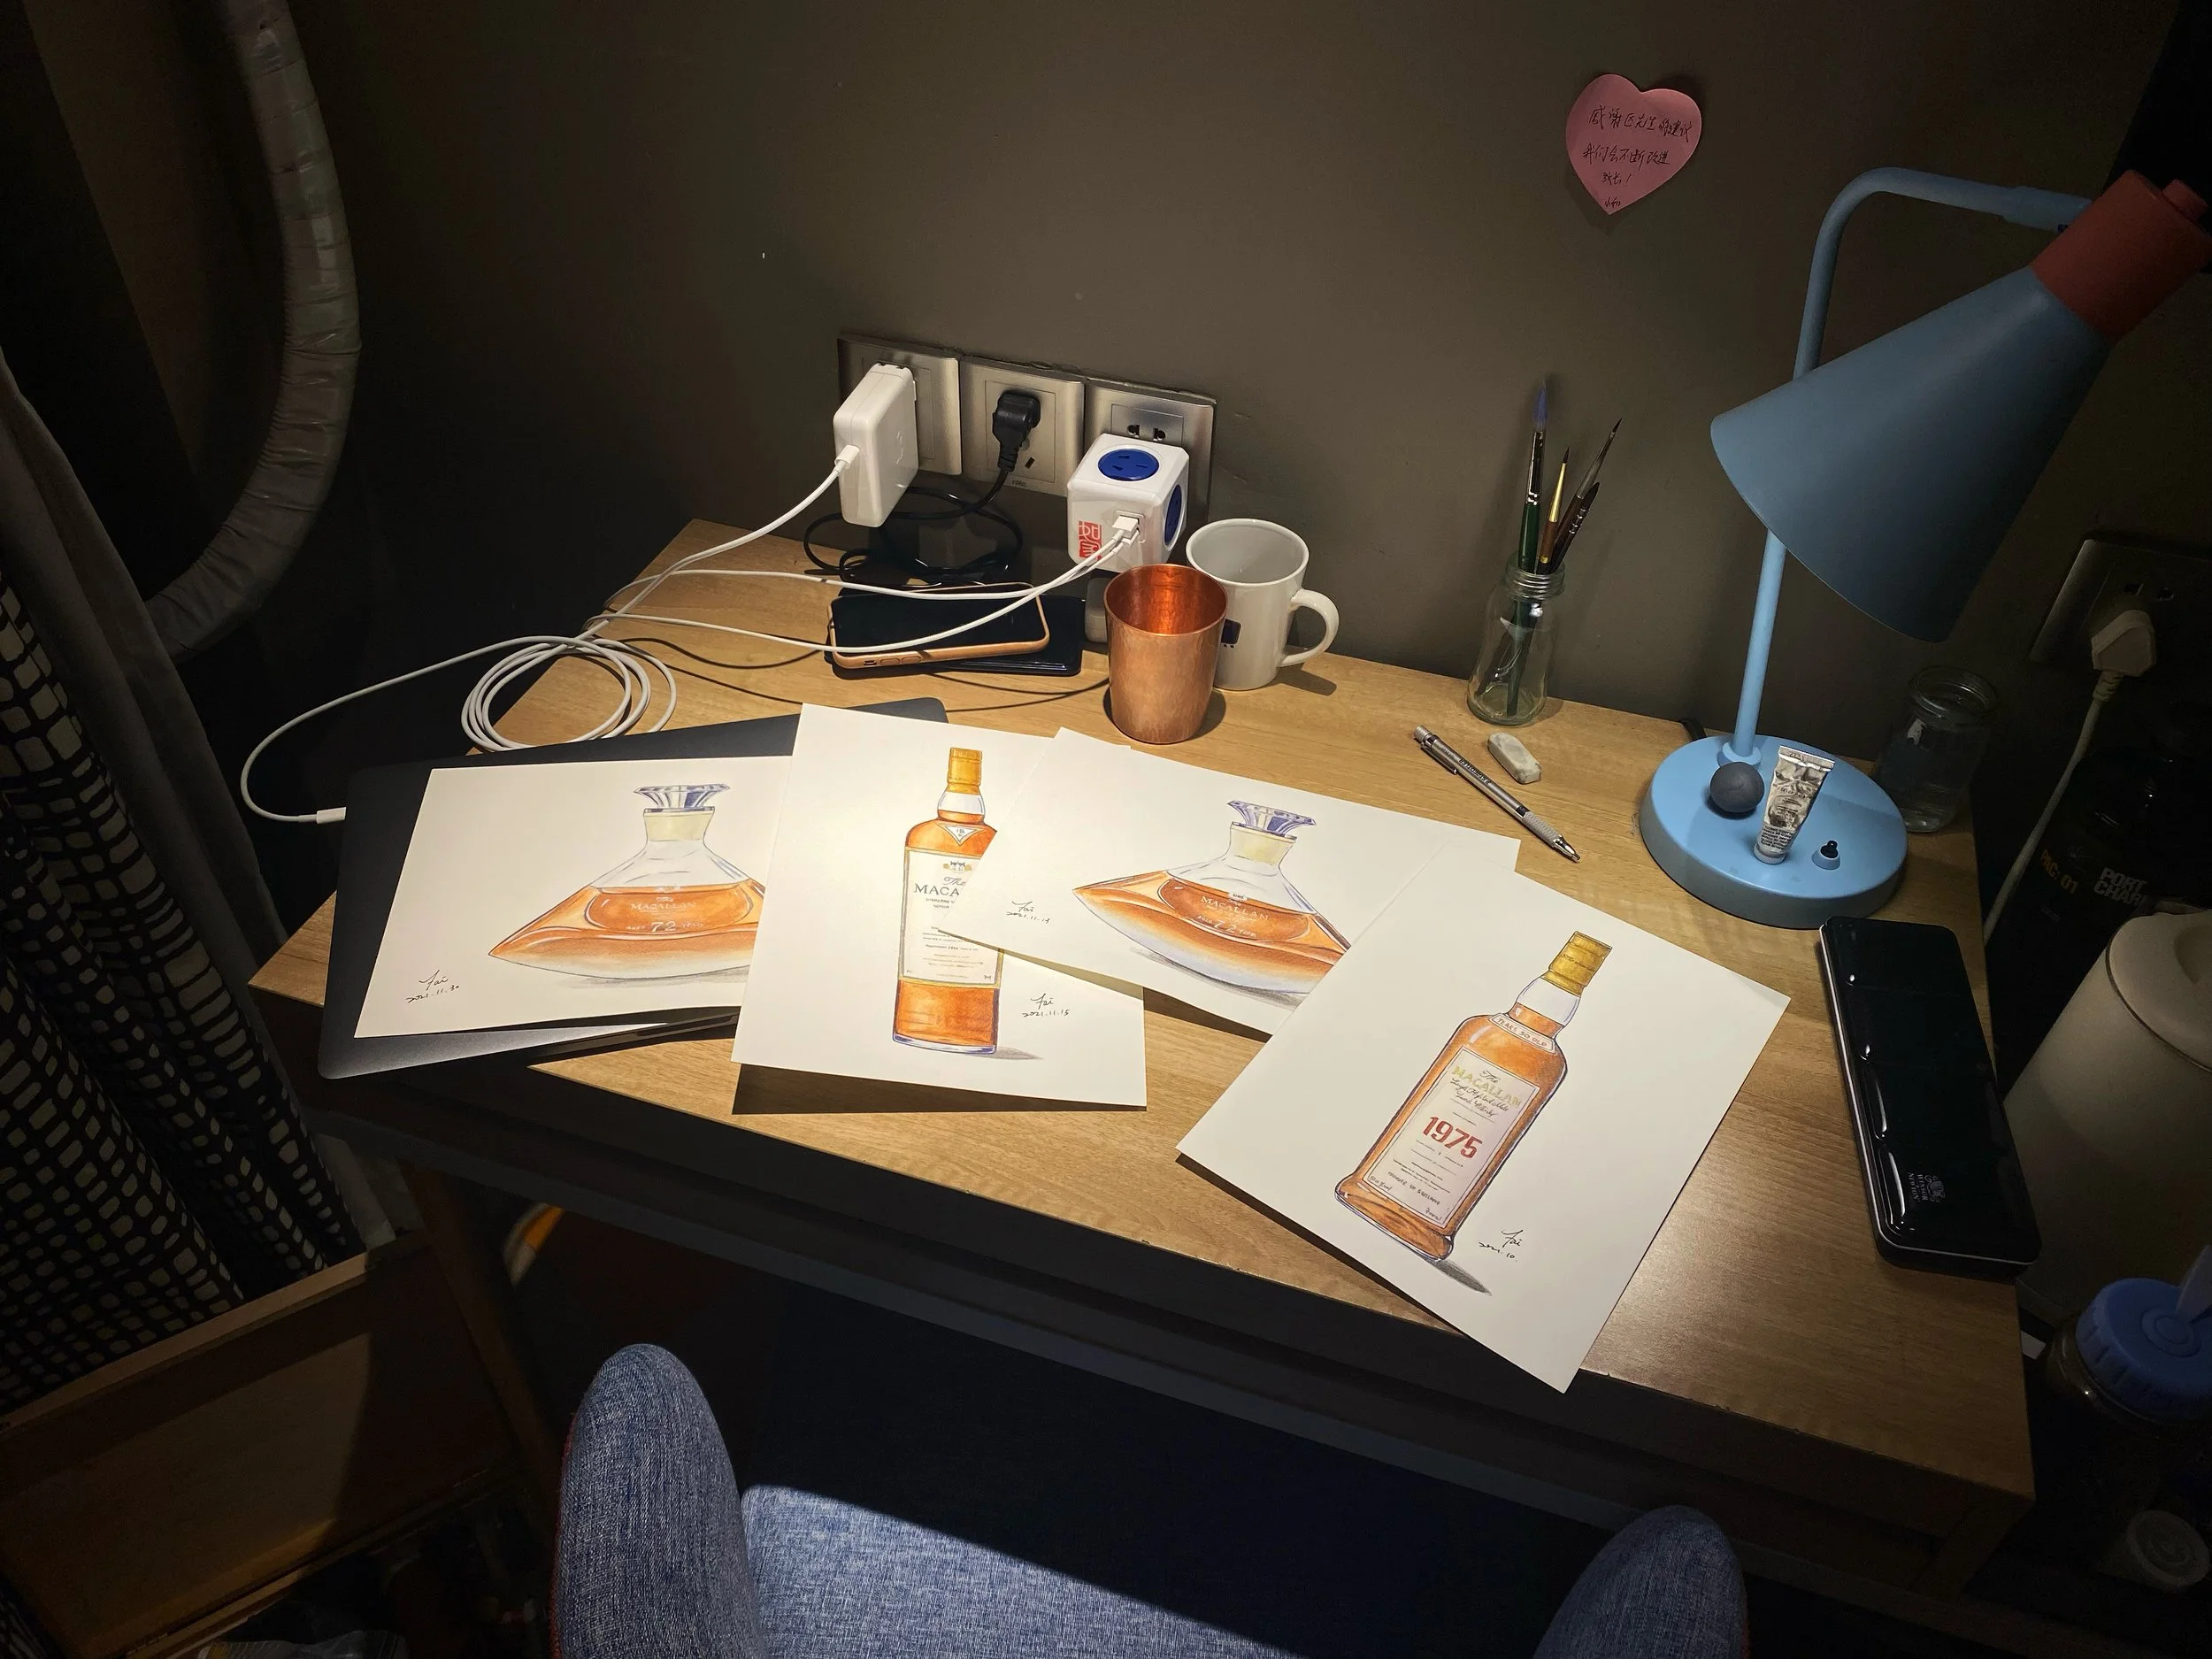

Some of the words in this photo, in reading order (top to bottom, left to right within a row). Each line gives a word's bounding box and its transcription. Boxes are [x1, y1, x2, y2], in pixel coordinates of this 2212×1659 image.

[913, 883, 960, 897] MACA
[2099, 867, 2148, 892] PORT
[1201, 895, 1269, 920] MACALLAN
[650, 920, 677, 933] 72
[1423, 1117, 1483, 1159] 1975
